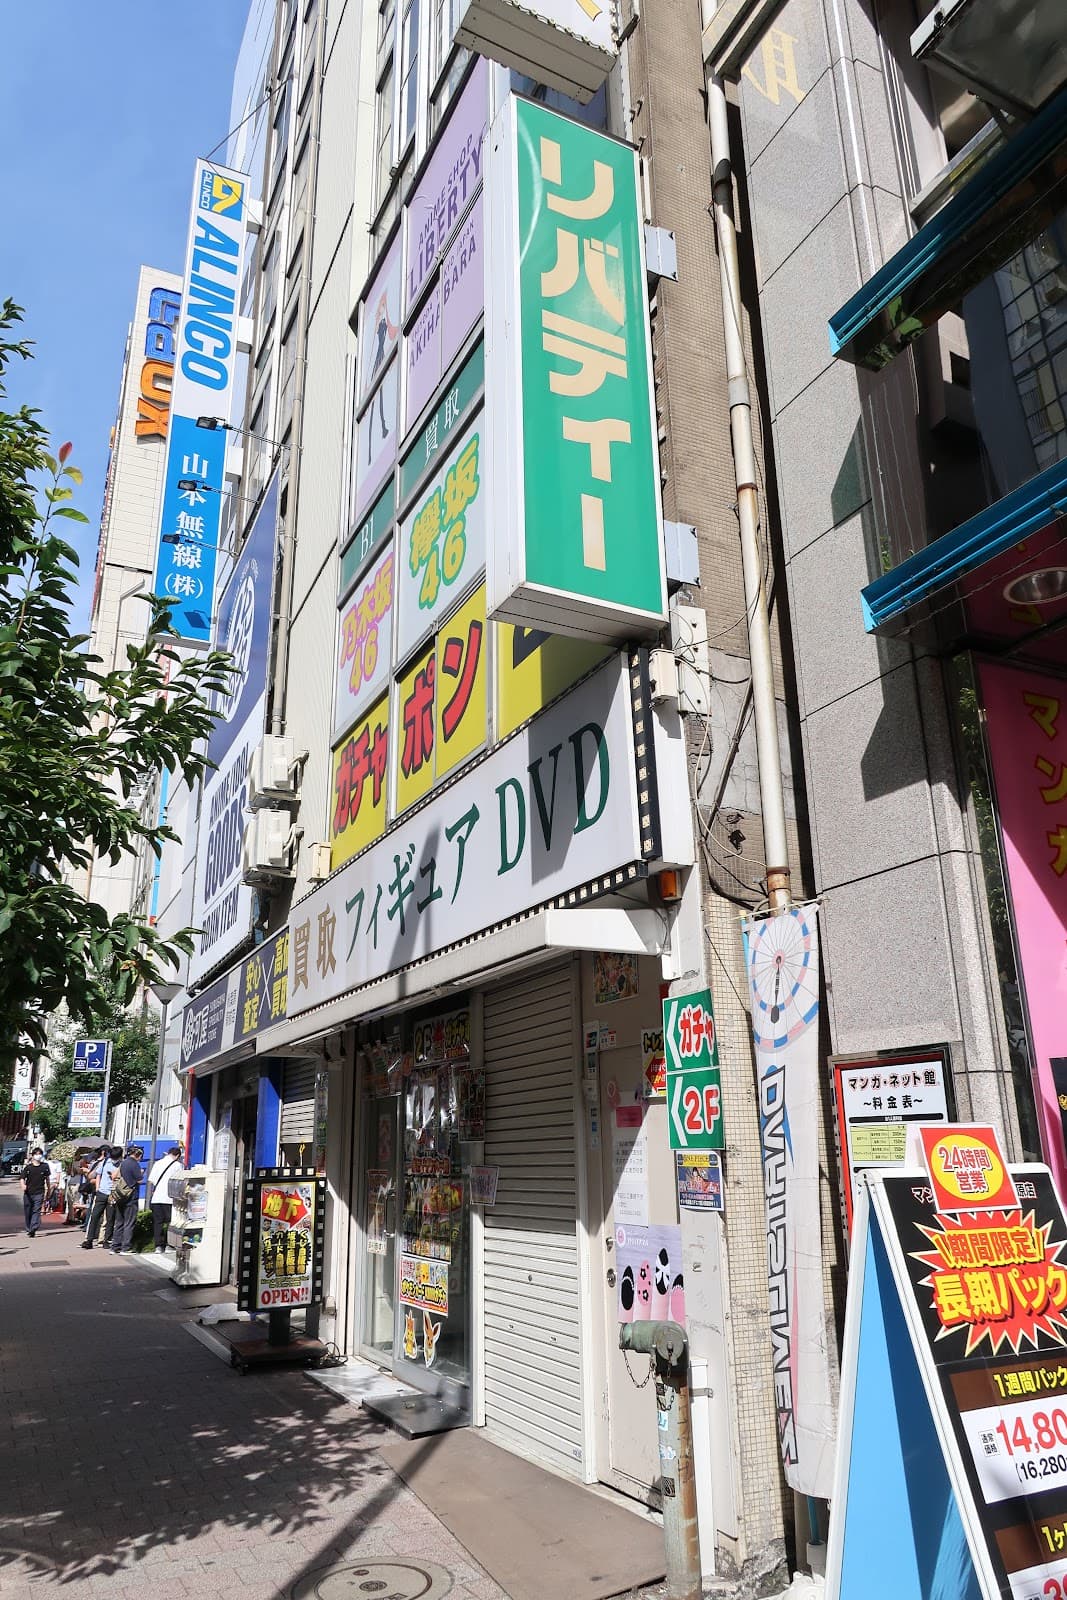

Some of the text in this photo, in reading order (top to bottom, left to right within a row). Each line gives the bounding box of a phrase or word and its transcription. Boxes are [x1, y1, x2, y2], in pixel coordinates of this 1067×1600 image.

[201, 171, 213, 209] ALINCO
[410, 136, 483, 301] LIBERTY
[418, 134, 472, 249] ANIME SHOP
[181, 216, 239, 391] ALINCO
[425, 388, 459, 463] 買取
[410, 433, 479, 578] 欅坂
[419, 520, 466, 609] 46
[340, 552, 394, 668] 乃木坂
[349, 627, 378, 696] 46
[204, 785, 247, 904] GOODS
[292, 722, 610, 997] 買取 フィギュア DVD
[85, 1043, 97, 1057] P
[679, 1004, 714, 1058] ガチャ
[684, 1086, 721, 1134] 2F
[939, 1146, 991, 1171] 24時間
[956, 1171, 989, 1193] 営業
[263, 1194, 302, 1221] 地下
[261, 1287, 308, 1305] OPEN!!
[934, 1266, 1067, 1321] 長期パック
[994, 1366, 1067, 1397] 1週間パック
